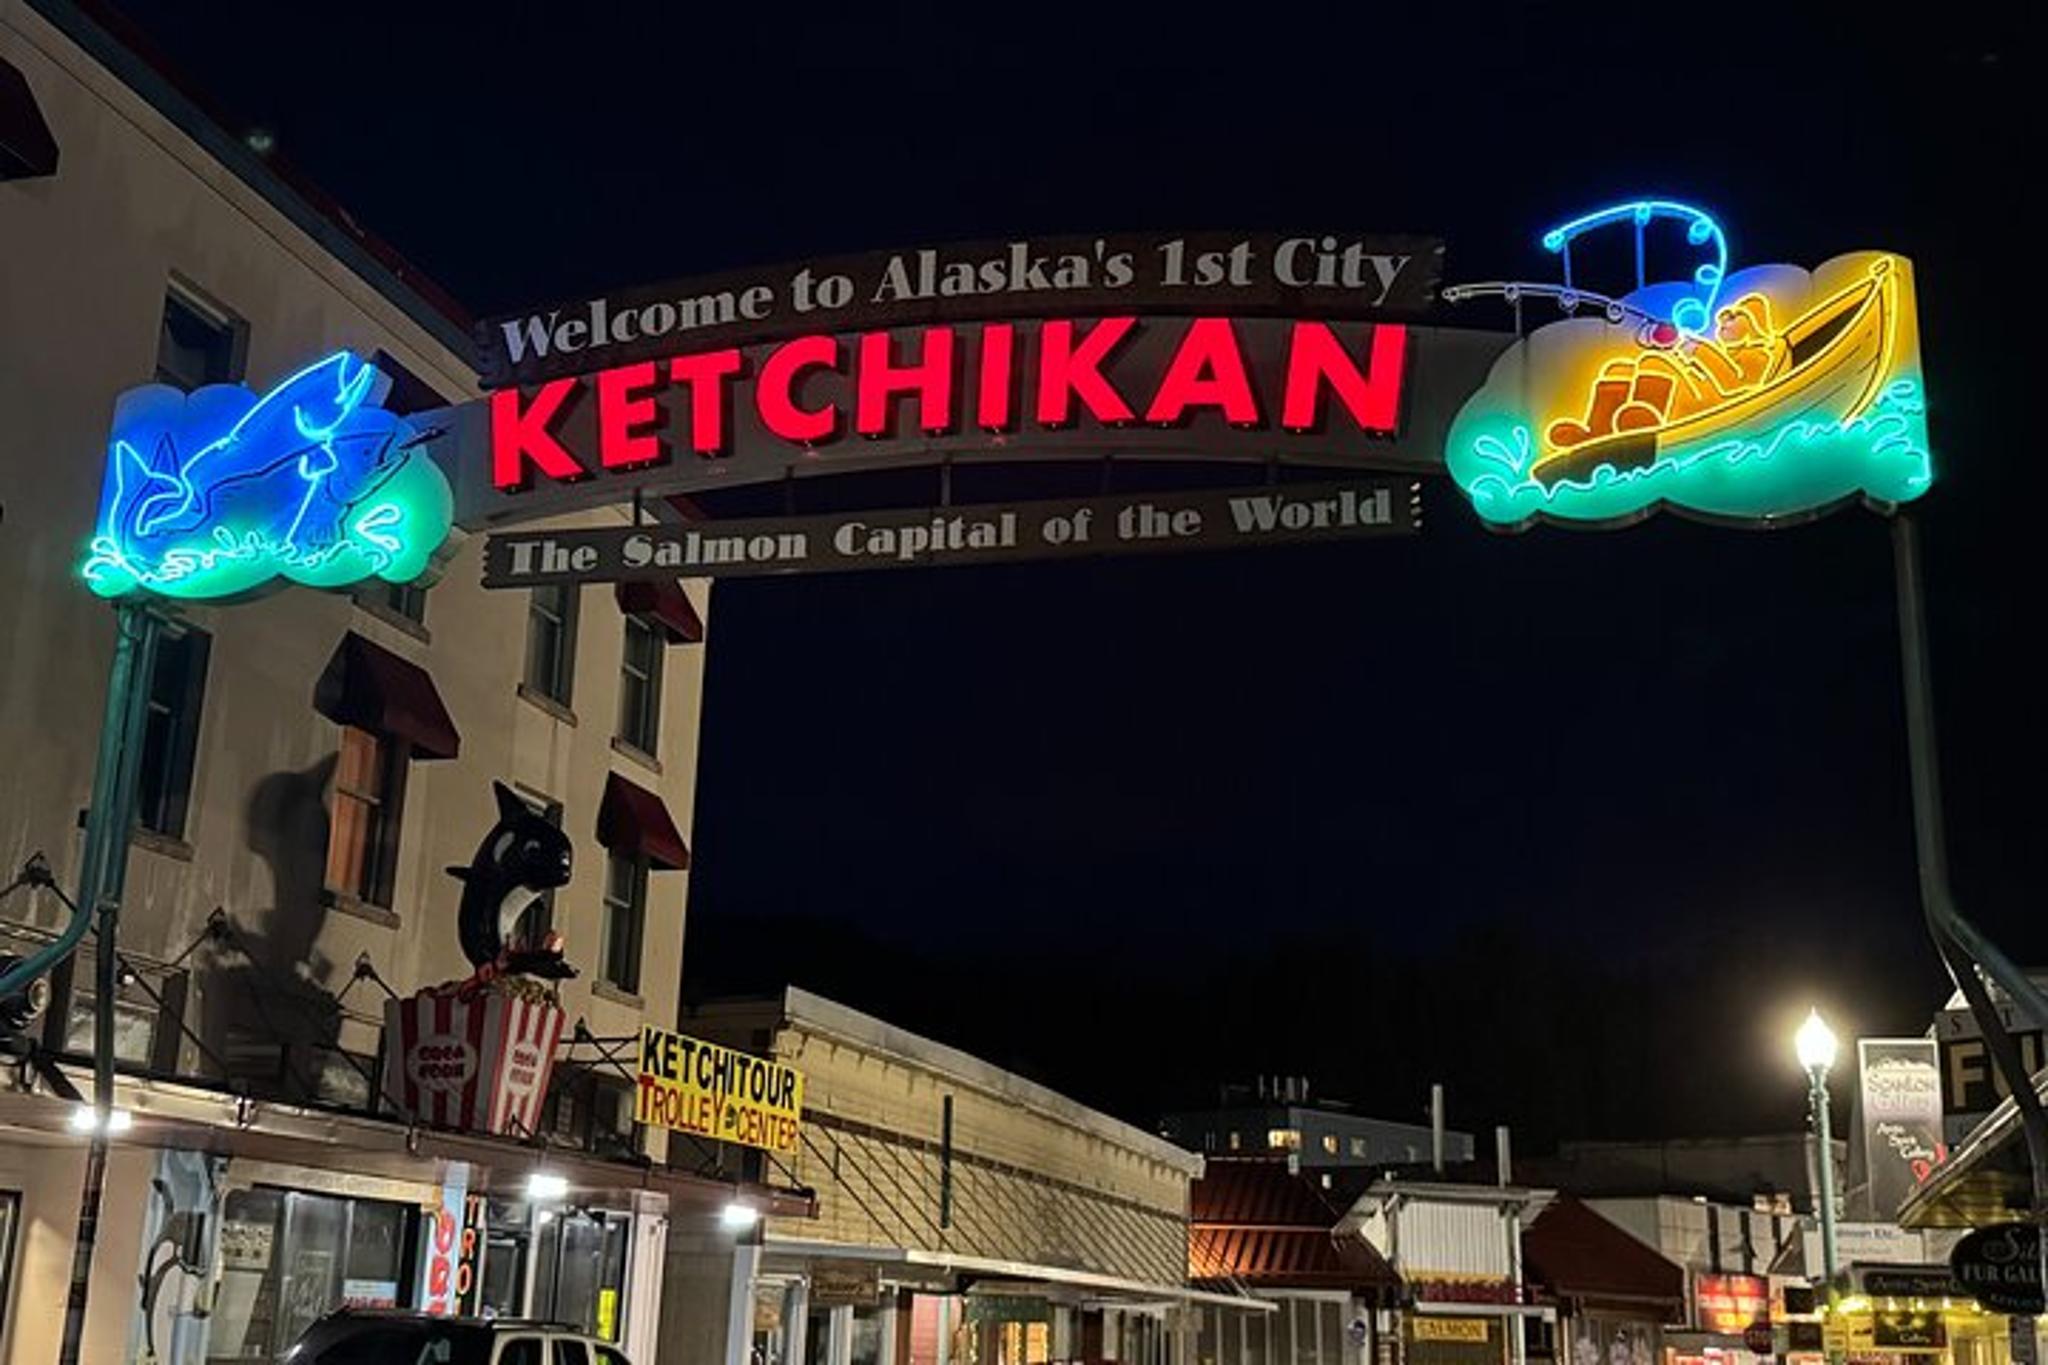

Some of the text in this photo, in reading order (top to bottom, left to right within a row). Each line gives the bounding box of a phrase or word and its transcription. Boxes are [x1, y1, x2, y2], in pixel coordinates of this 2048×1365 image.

[501, 236, 1412, 364] Welcome to Alaska's 1st City
[489, 316, 1407, 490] KETCHIKAN
[506, 489, 1392, 577] The Salmon Capital of the World
[642, 1027, 795, 1111] KETCHITOUR
[638, 1073, 798, 1154] TROLLEY CENTER
